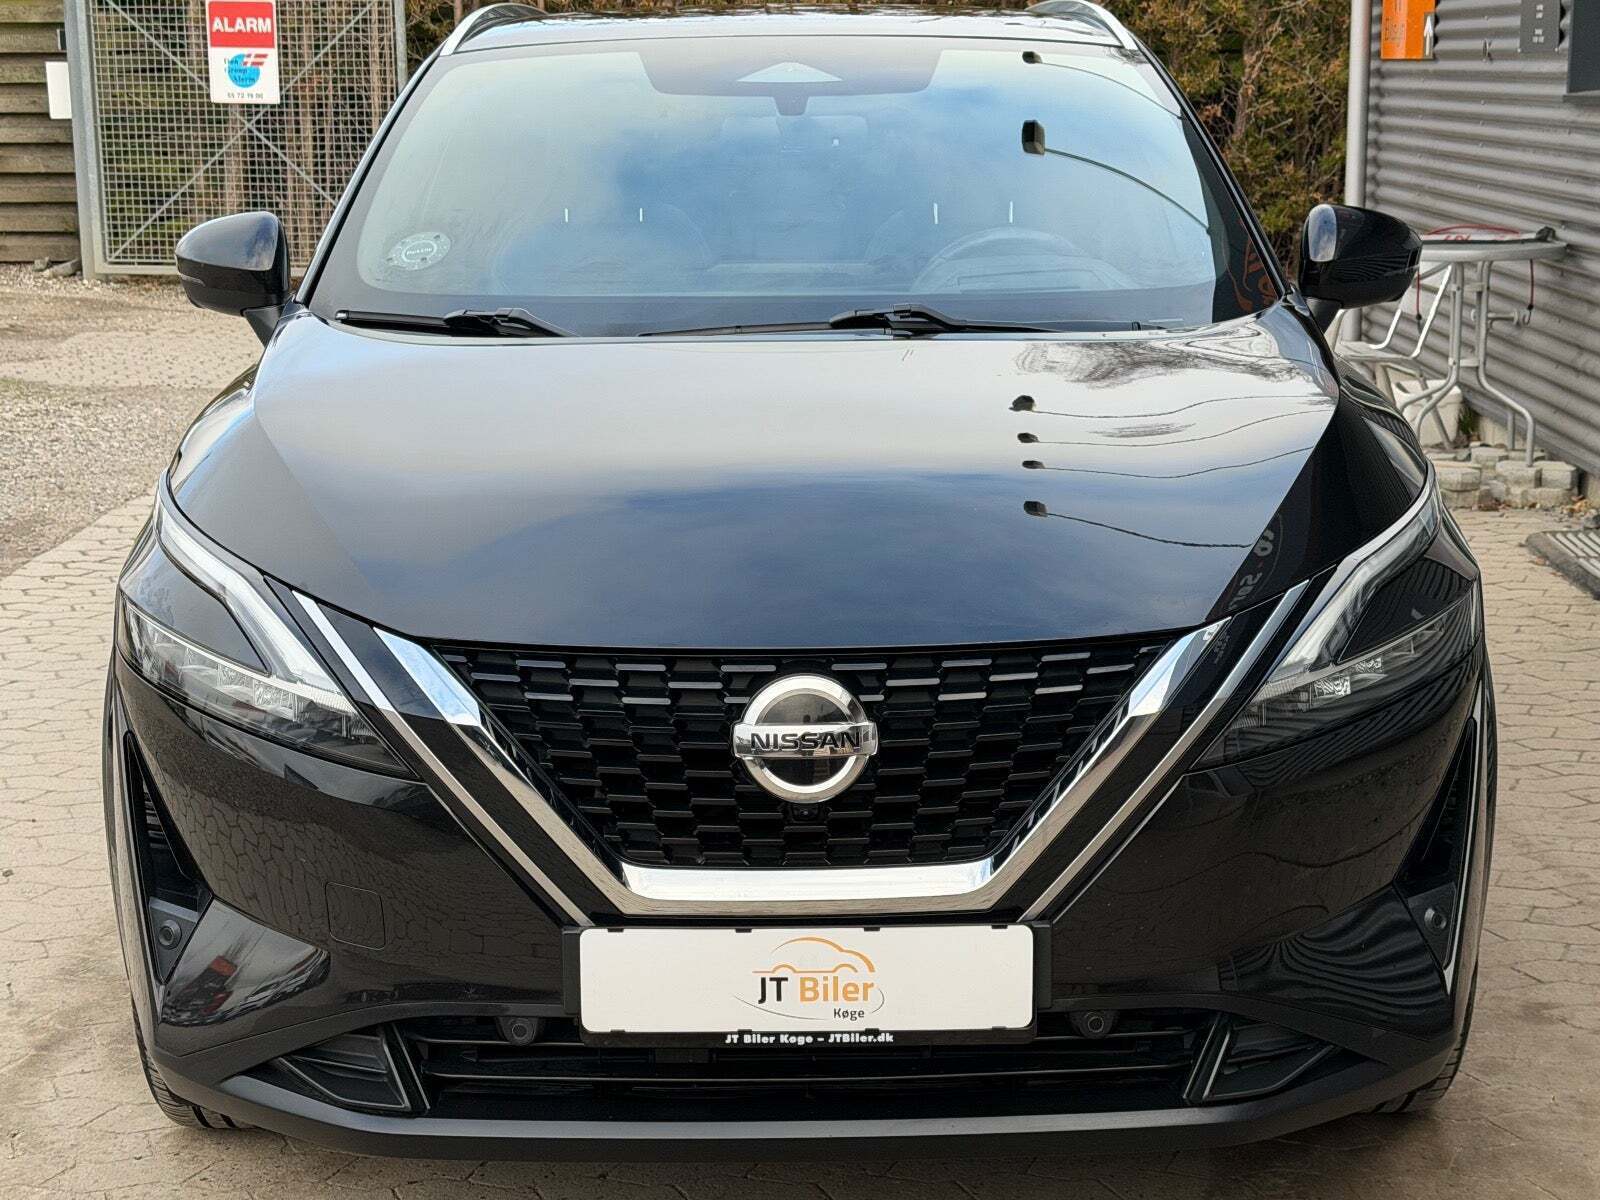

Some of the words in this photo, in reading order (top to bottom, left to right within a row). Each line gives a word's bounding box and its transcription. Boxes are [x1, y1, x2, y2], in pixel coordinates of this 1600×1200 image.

[211, 16, 272, 33] ALARM
[233, 76, 257, 84] Alarm
[750, 732, 861, 750] NISSAN
[757, 976, 789, 1005] JT
[799, 976, 875, 1003] Biler
[833, 1008, 865, 1021] Køge
[725, 1034, 739, 1044] JT
[743, 1034, 776, 1044] Biler
[828, 1033, 894, 1044] JTBiler.dk
